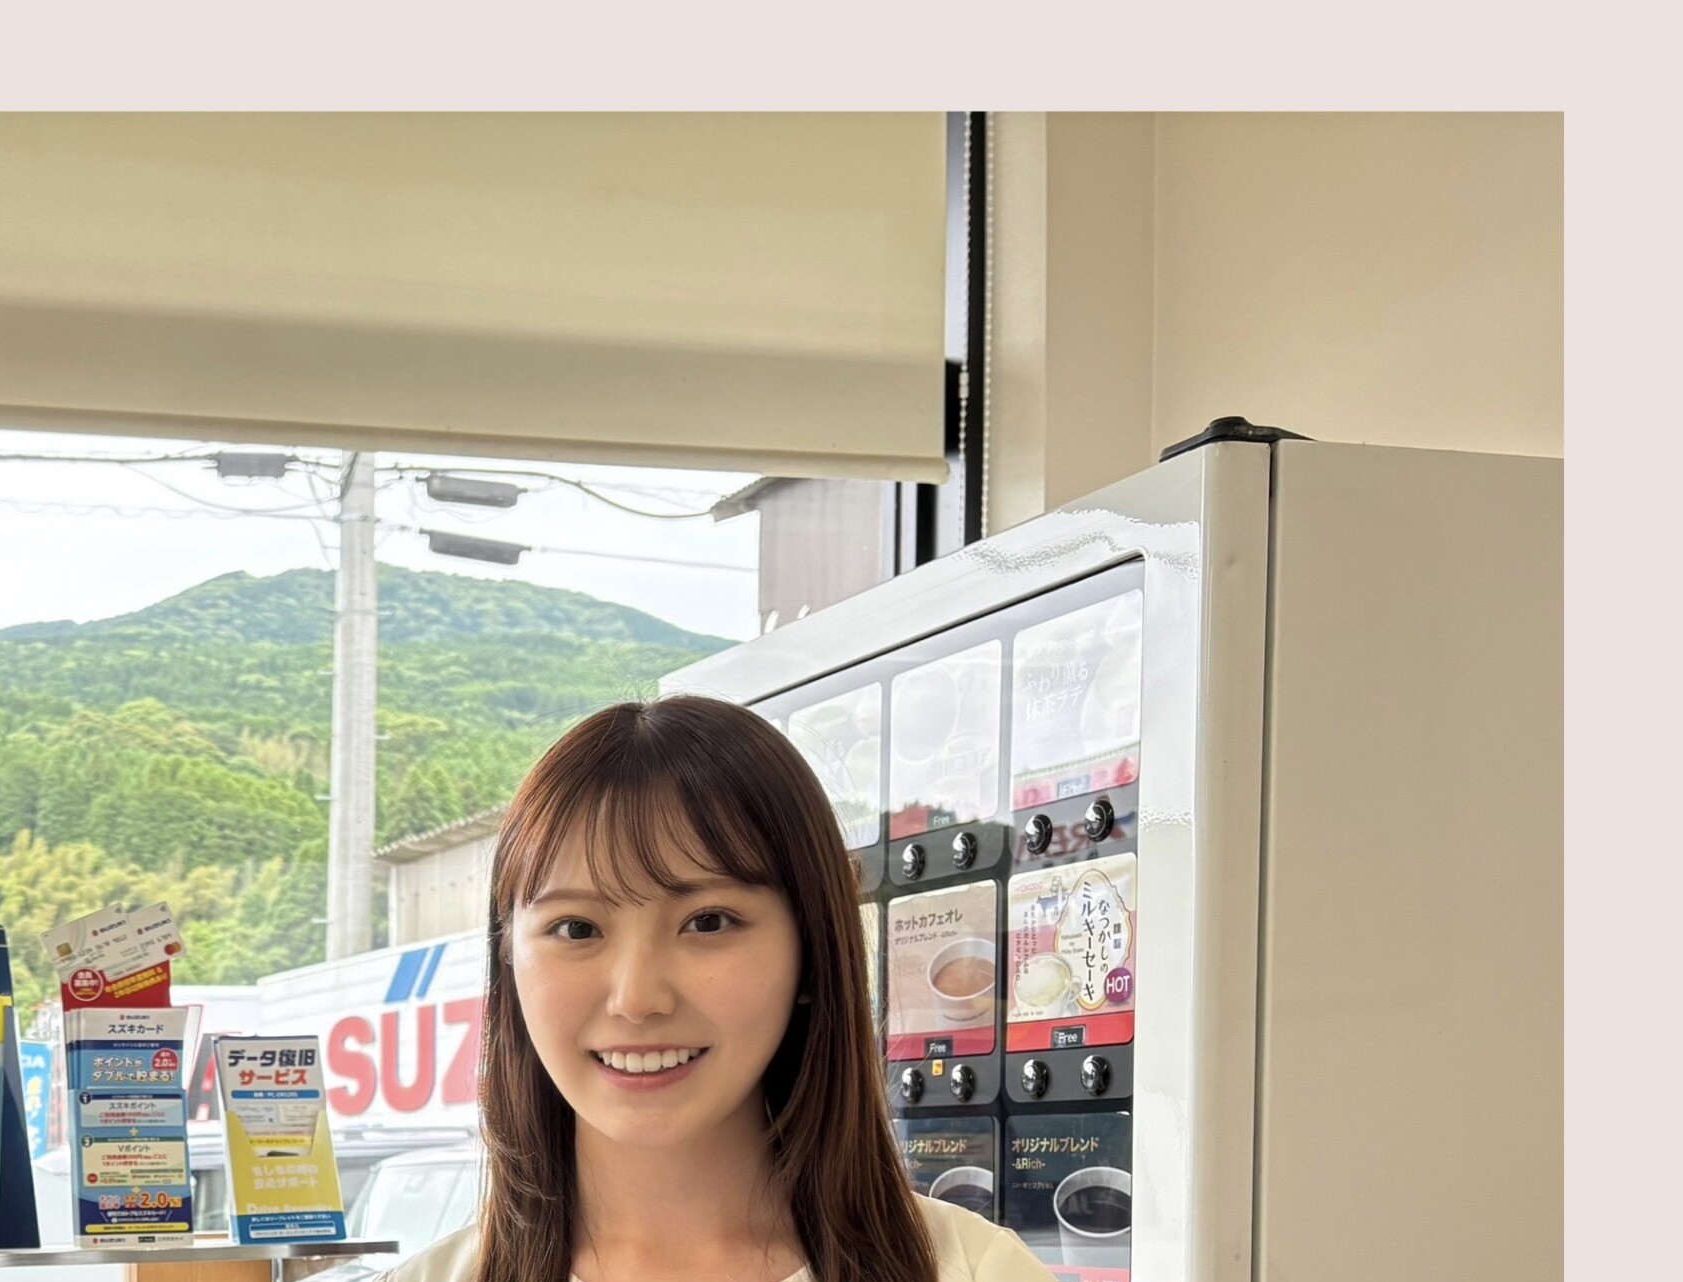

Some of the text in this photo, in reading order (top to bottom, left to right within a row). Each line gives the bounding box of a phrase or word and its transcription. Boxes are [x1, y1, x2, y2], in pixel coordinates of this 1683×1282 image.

[933, 814, 950, 826] Free
[894, 909, 963, 932] ホットカフェオレ
[1097, 900, 1111, 973] なつかしの
[1106, 975, 1131, 994] HOT
[108, 1024, 165, 1034] スズキカード
[1057, 1032, 1078, 1045] Free
[929, 1042, 947, 1053] Free
[228, 1048, 316, 1068] データ復旧
[239, 1068, 308, 1086] サービス
[902, 1138, 967, 1153] リジナルブレンド
[1012, 1136, 1100, 1153] オリジナルブレンド
